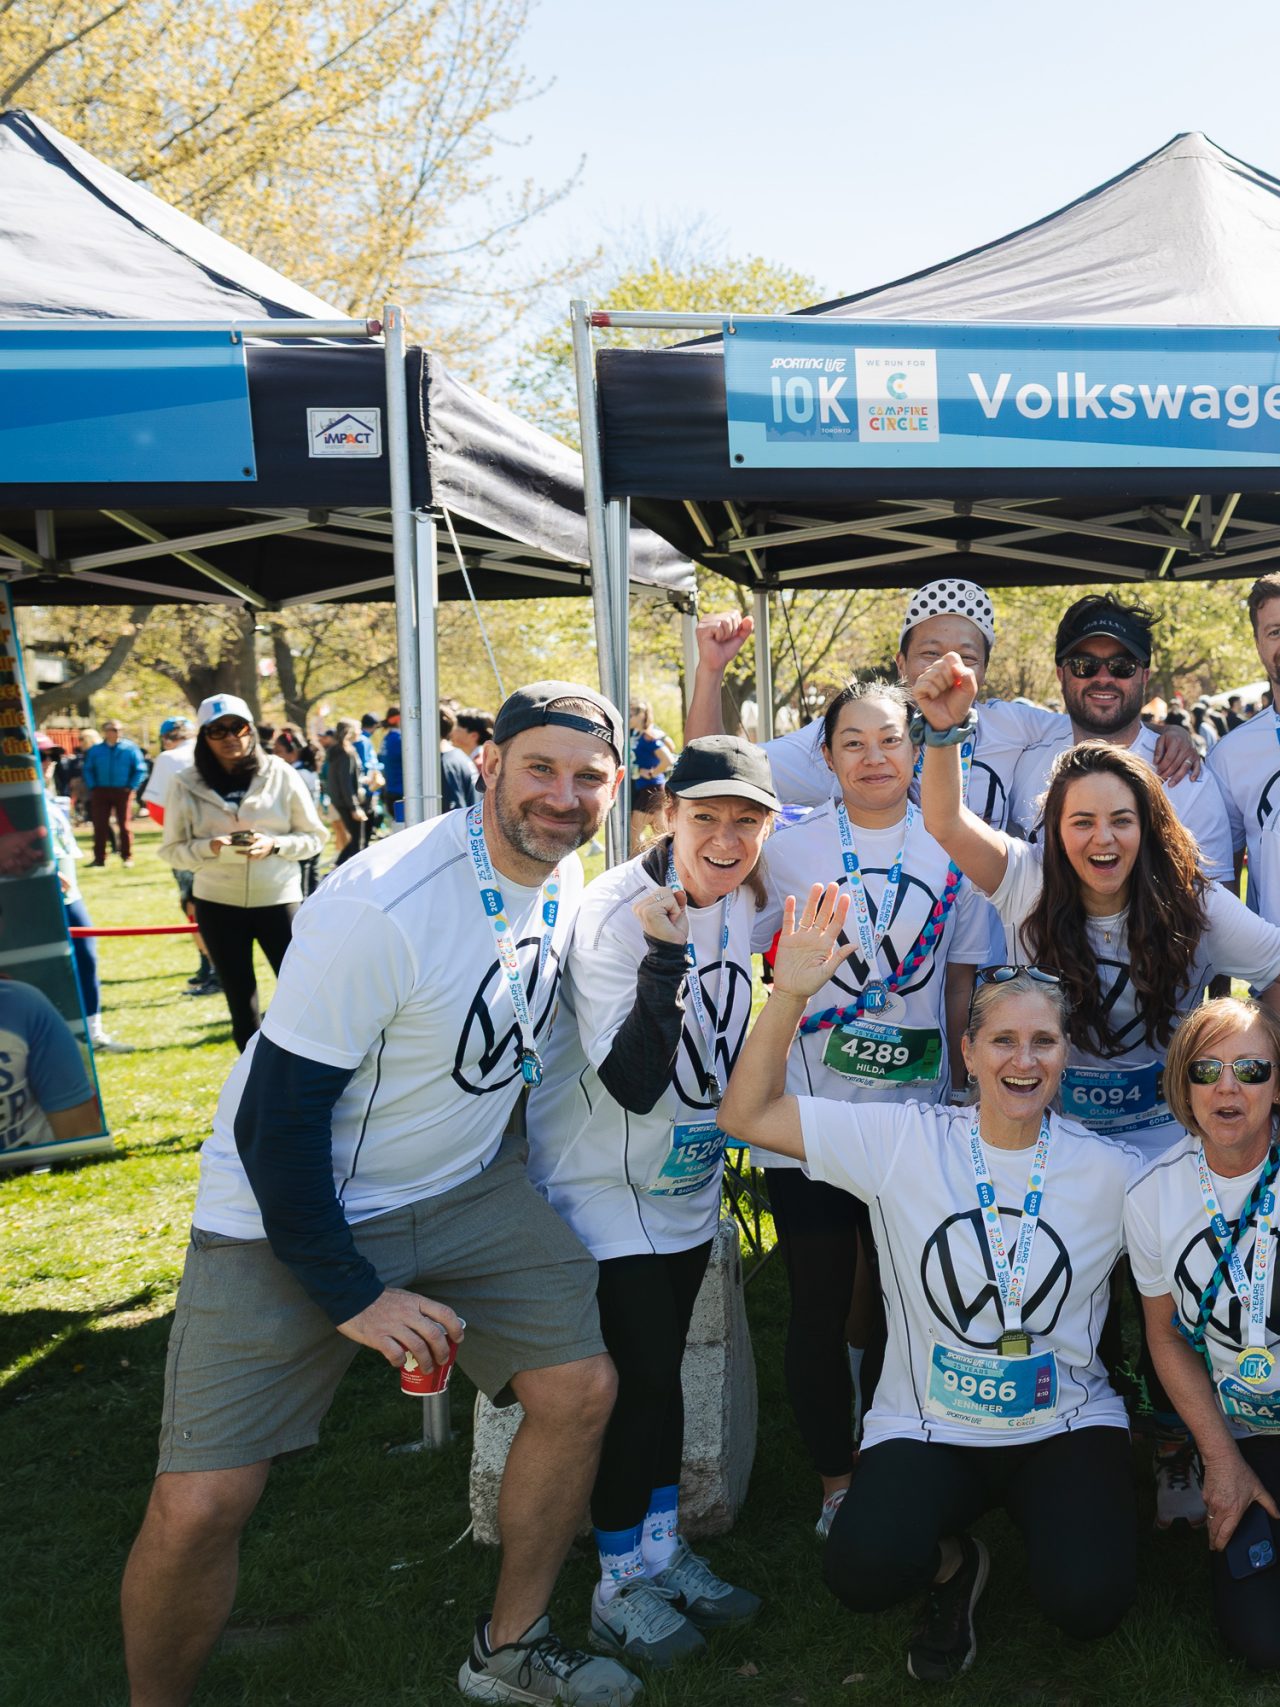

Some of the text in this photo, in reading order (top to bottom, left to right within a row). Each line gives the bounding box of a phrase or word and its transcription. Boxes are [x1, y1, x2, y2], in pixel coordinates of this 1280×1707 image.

[771, 376, 850, 423] 10K
[868, 406, 928, 416] CAMPFIRE
[869, 417, 928, 431] CIRCLE
[838, 816, 848, 838] YEARS
[471, 840, 483, 869] YEARS
[486, 891, 498, 912] 2025
[883, 899, 894, 924] YEARS
[866, 993, 882, 1007] 10K
[841, 1038, 909, 1066] 4289
[856, 1063, 885, 1075] HILDA
[1072, 1085, 1141, 1105] 6094
[1090, 1107, 1125, 1115] GLORIA
[1149, 1115, 1170, 1126] 6094
[970, 1138, 981, 1166] YEARS
[980, 1185, 991, 1204] 2025
[1029, 1194, 1038, 1213] 2025
[1263, 1193, 1271, 1212] 2025
[1215, 1217, 1226, 1236] 2025
[1021, 1236, 1032, 1264] YEARS
[1260, 1238, 1268, 1268] CIRCLE
[1232, 1254, 1246, 1281] YEARS
[1252, 1283, 1260, 1323] 25 YEARS
[965, 1366, 989, 1375] YEARS
[985, 1360, 999, 1370] 10K
[1244, 1361, 1267, 1377] 10K
[943, 1370, 1017, 1401] 9966
[952, 1399, 1003, 1413] JENNIFER
